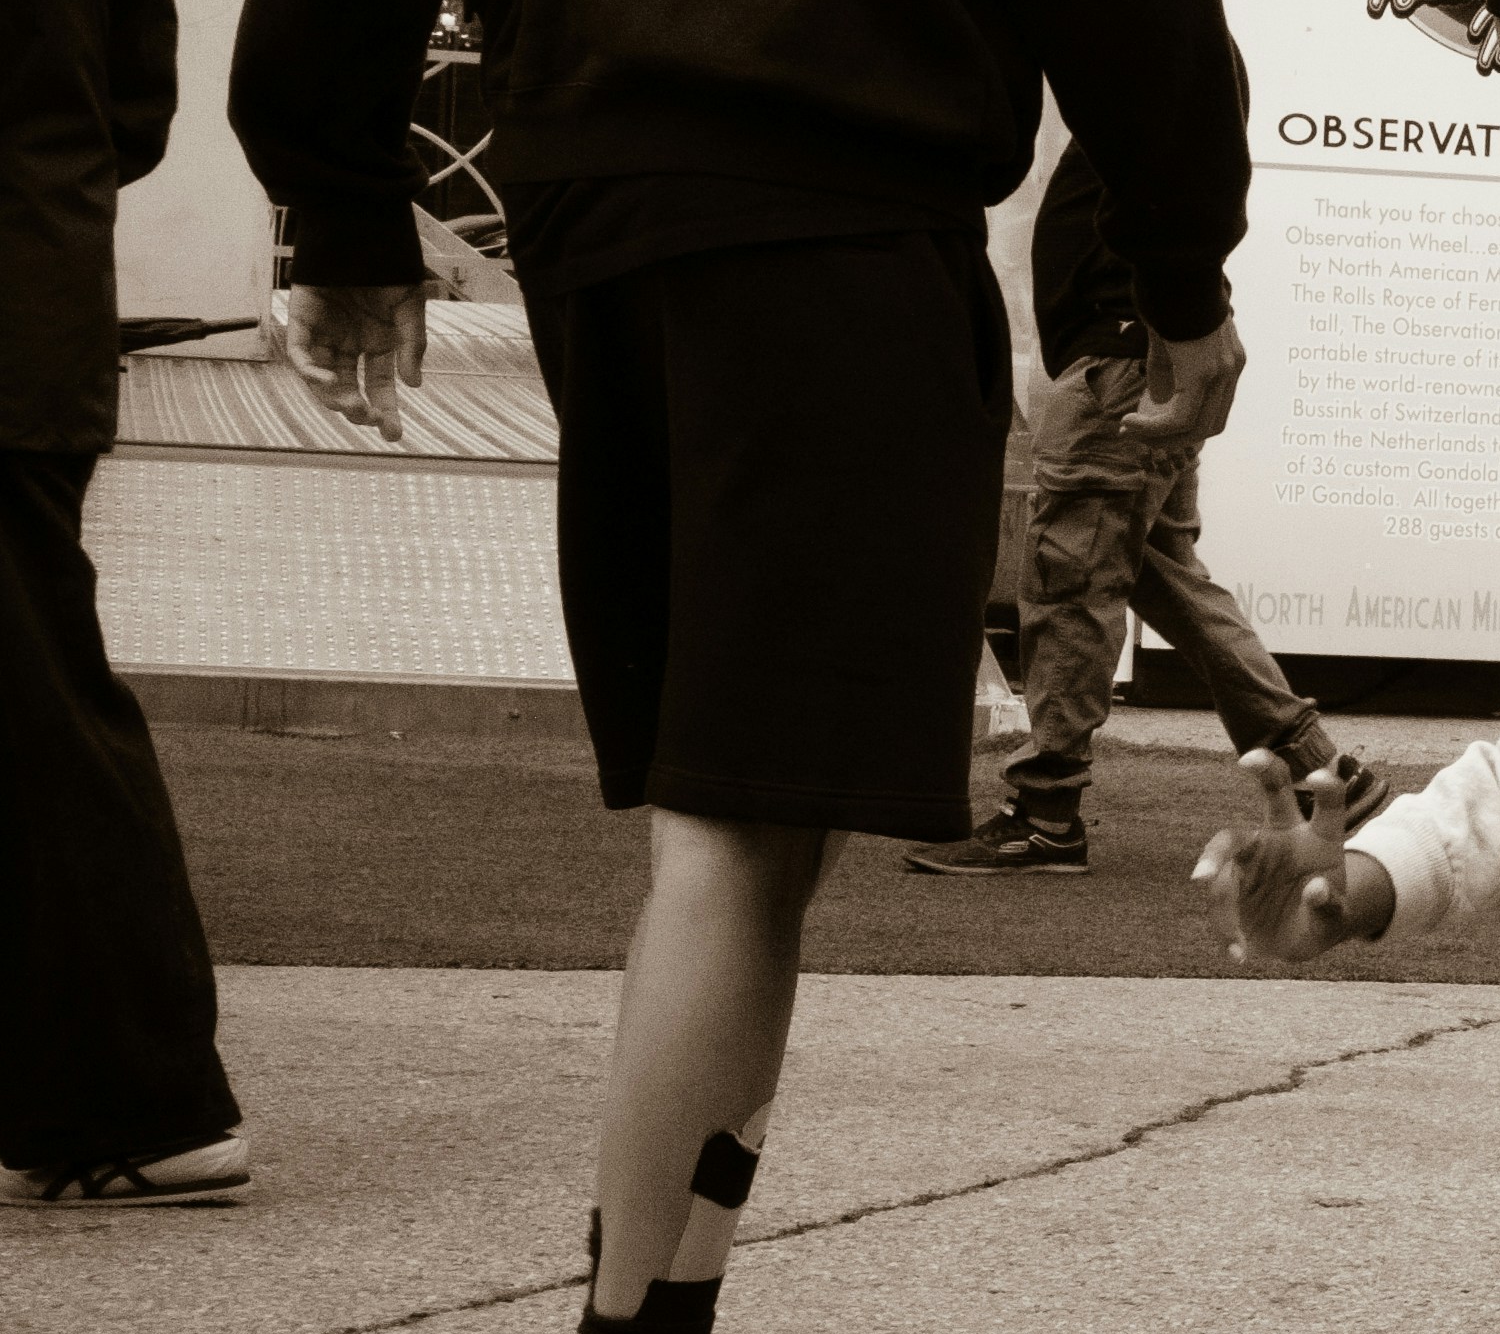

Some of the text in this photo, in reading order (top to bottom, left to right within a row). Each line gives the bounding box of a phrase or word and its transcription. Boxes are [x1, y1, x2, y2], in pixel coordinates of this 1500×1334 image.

[1314, 197, 1372, 220] Thank
[1378, 207, 1413, 226] you
[1418, 202, 1446, 224] for
[1285, 225, 1402, 250] Observation
[1299, 254, 1322, 279] by
[1328, 257, 1382, 277] North
[1388, 261, 1479, 282] American
[1291, 283, 1326, 304] The
[1333, 285, 1376, 306] Rolls
[1382, 287, 1436, 313] Royce
[1442, 290, 1462, 310] of
[1309, 313, 1344, 336] tall,
[1352, 314, 1386, 335] The
[1288, 343, 1368, 364] portable
[1375, 347, 1456, 367] structure
[1463, 348, 1482, 368] of
[1298, 369, 1320, 393] by
[1326, 371, 1356, 391] the
[1292, 397, 1363, 420] Bussink
[1369, 400, 1390, 421] of
[1281, 424, 1327, 447] from
[1332, 427, 1364, 449] the
[1369, 430, 1487, 454] Netherlands
[1285, 453, 1307, 475] of
[1311, 455, 1337, 477] 36
[1342, 460, 1411, 479] custom
[1274, 483, 1306, 503] VIP
[1311, 483, 1401, 508] Gondola.
[1412, 488, 1439, 508] All
[1386, 515, 1423, 537] 288
[1428, 521, 1489, 542] guests
[1346, 585, 1462, 631] AMERICAN
